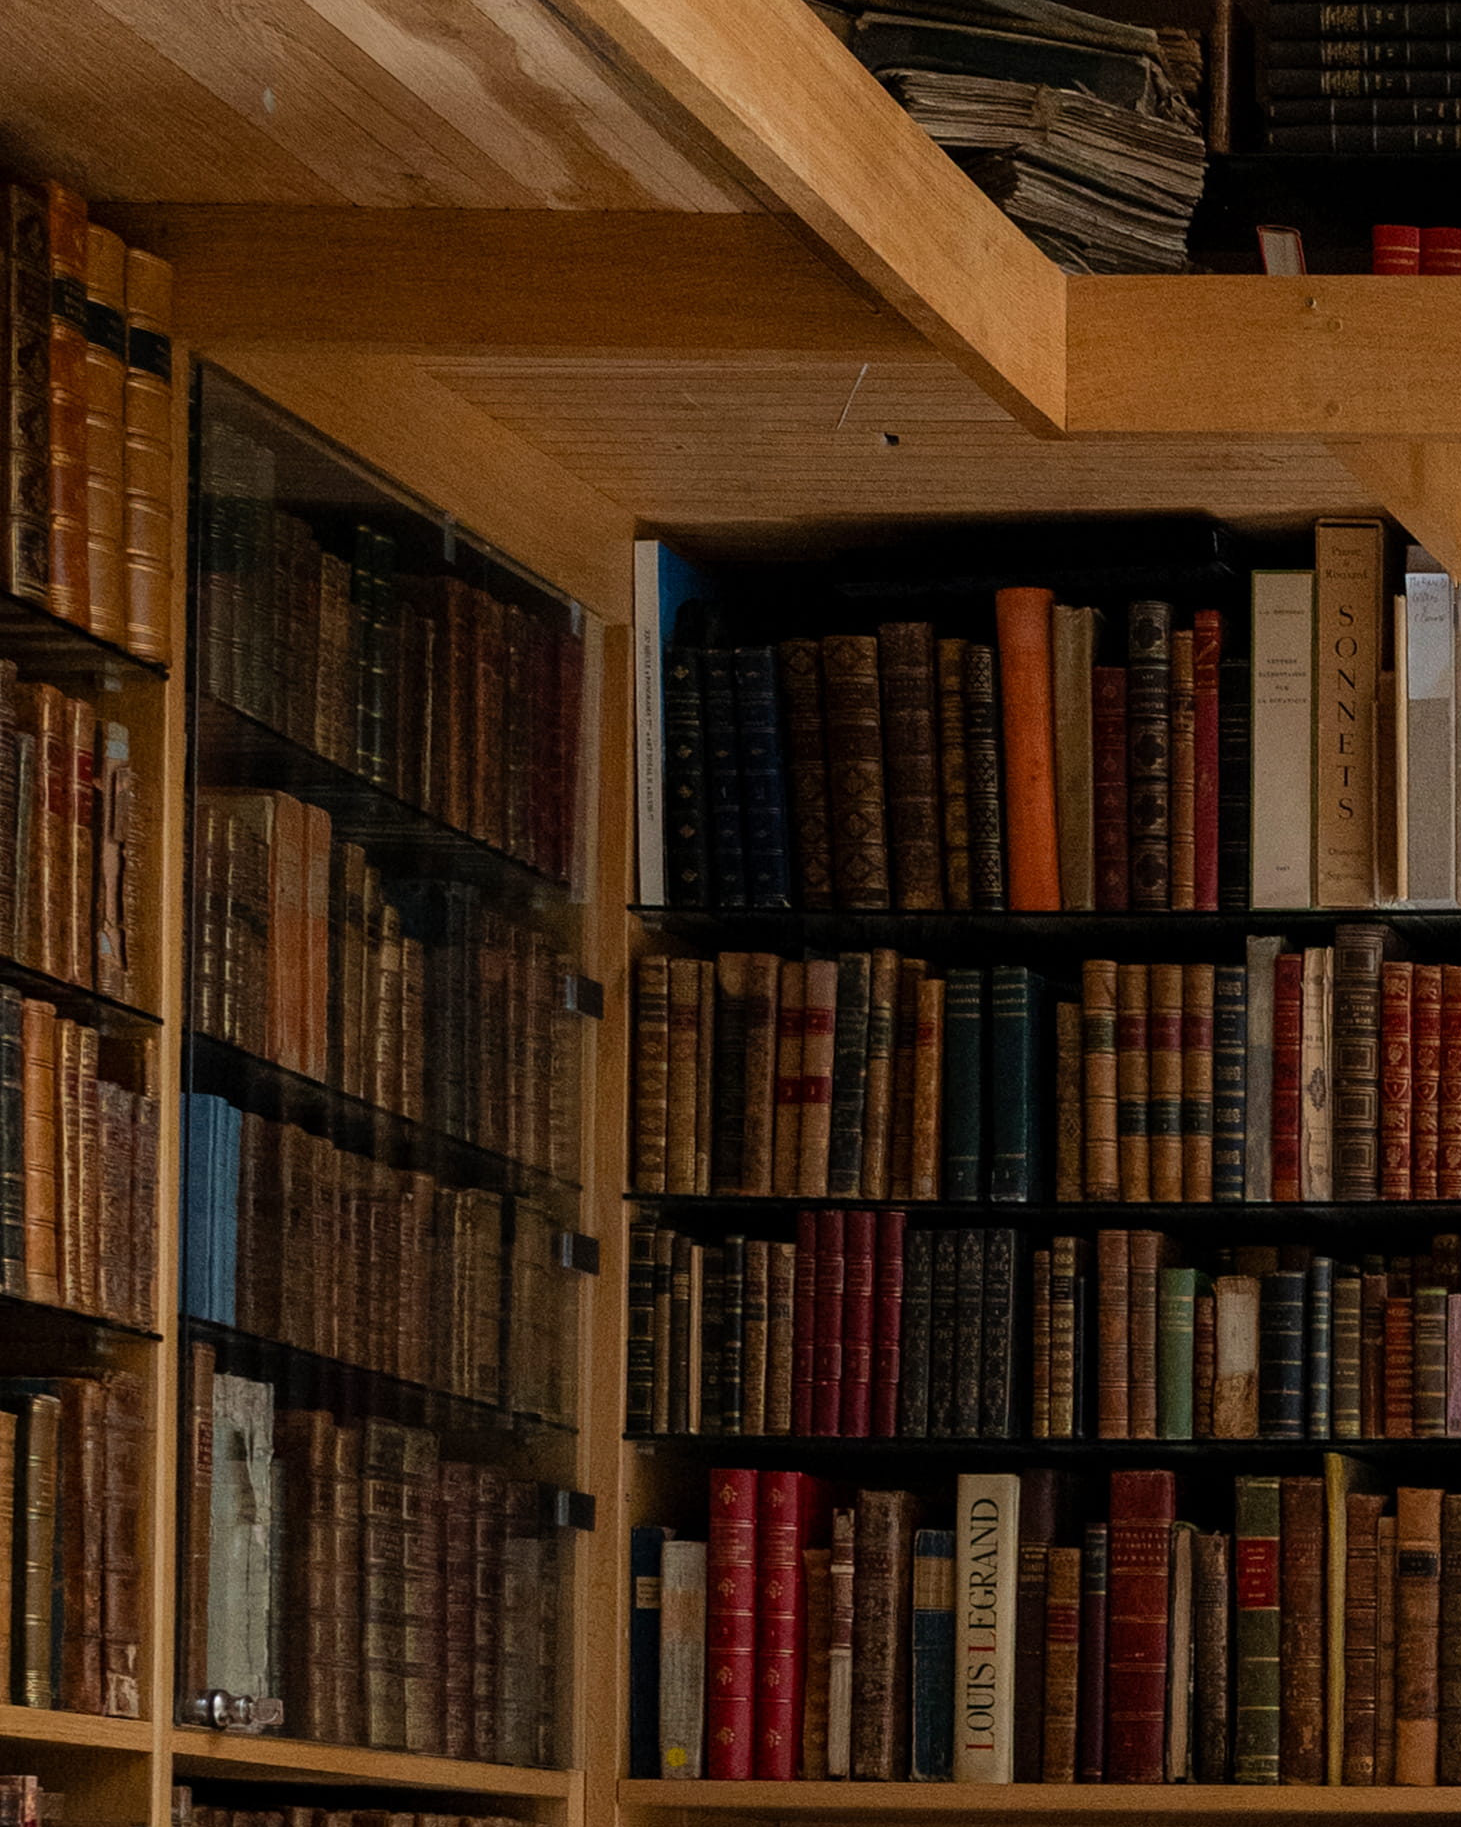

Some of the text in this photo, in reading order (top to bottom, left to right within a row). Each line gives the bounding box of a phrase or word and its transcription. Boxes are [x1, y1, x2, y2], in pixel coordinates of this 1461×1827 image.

[1334, 605, 1358, 820] SONNETS
[965, 1498, 999, 1751] LOUIS LEGRAND
